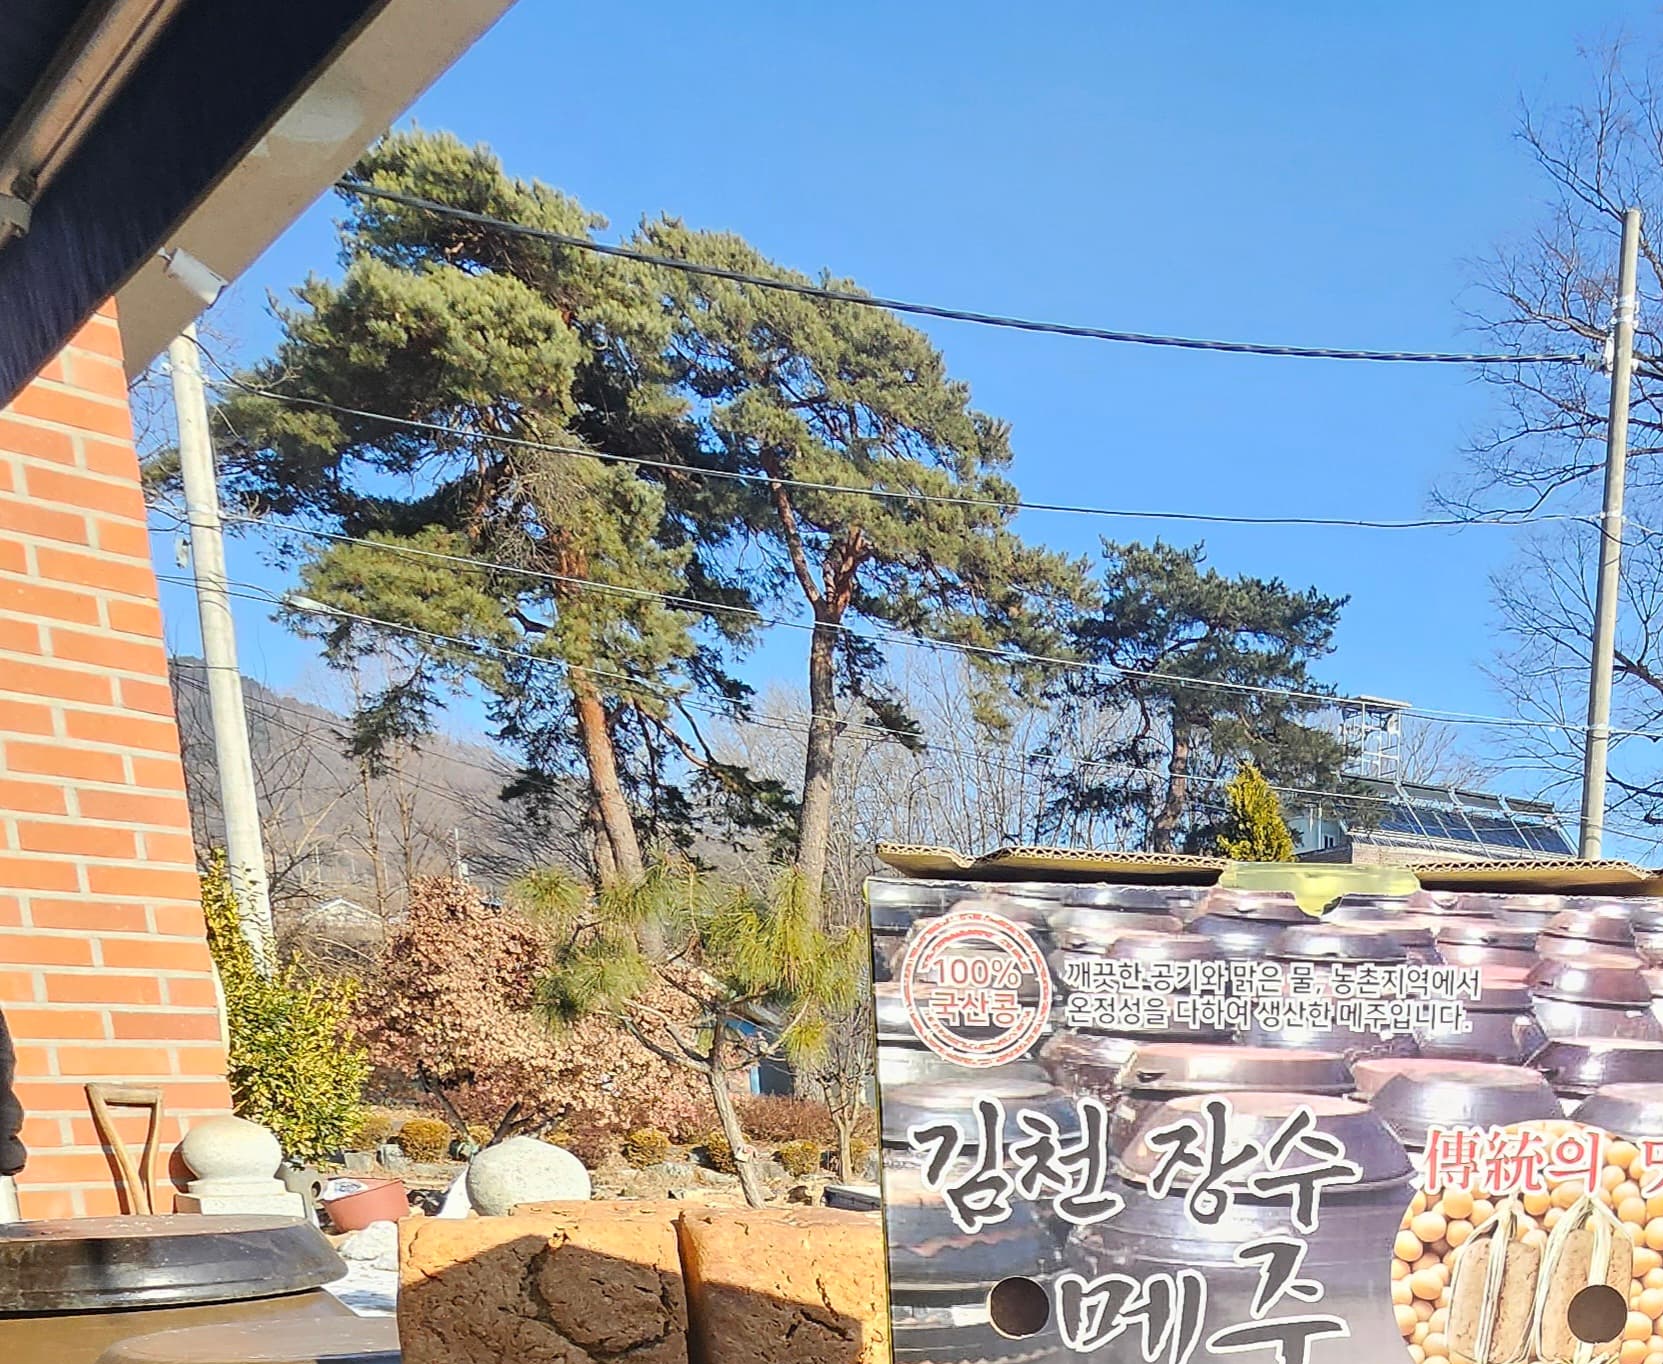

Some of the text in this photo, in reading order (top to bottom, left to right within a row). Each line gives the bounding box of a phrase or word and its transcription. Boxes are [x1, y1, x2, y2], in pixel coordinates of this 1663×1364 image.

[933, 957, 1022, 987] 100%
[1066, 961, 1480, 998] 깨끗한 공기와 맑은 물, 농촌지역에서
[931, 991, 1020, 1026] 국산콩
[1067, 996, 1472, 1031] 온정성을 다하여 생산한 메주입니다.
[910, 1097, 1362, 1232] 김천 장수
[1424, 1128, 1600, 1193] 傳統의
